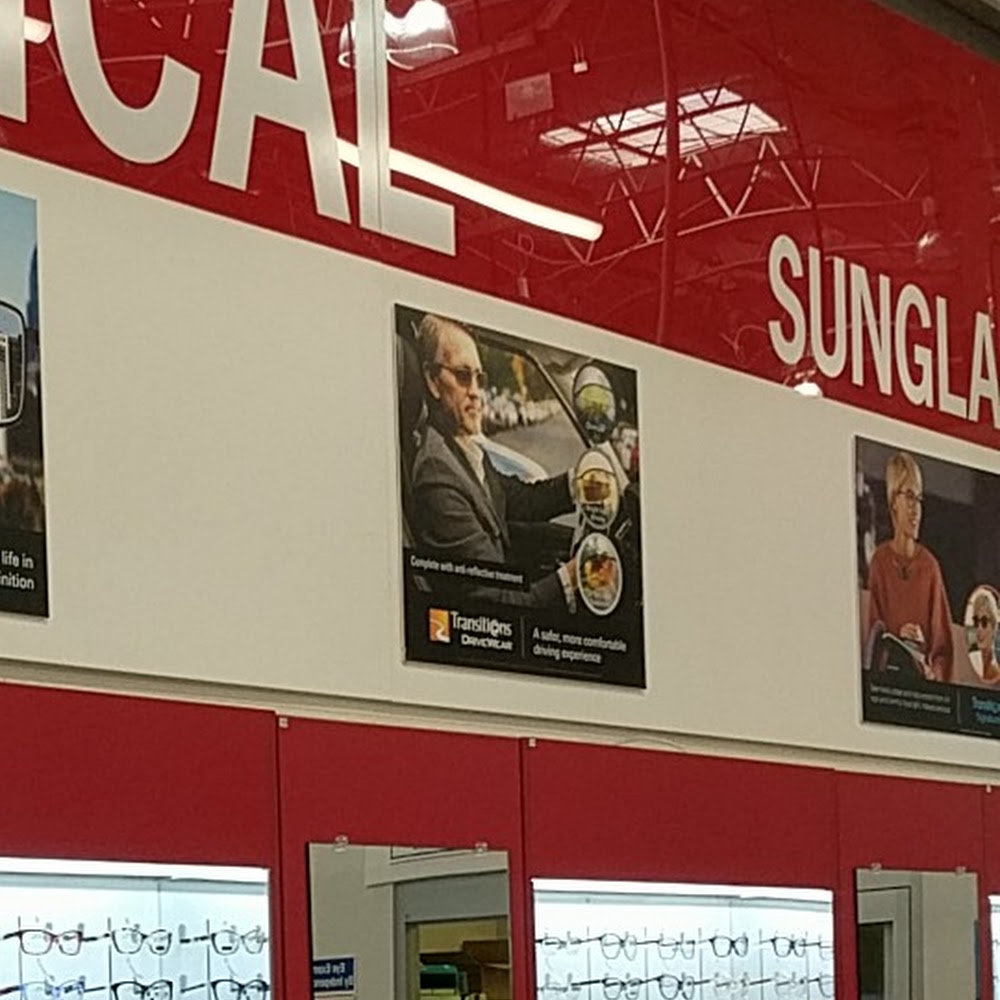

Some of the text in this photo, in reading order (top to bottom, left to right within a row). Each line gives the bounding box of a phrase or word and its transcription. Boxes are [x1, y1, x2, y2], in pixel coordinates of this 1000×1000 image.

[768, 234, 1000, 430] SUNGLA
[1, 550, 20, 567] life
[21, 553, 34, 569] in
[410, 555, 440, 572] Complete
[440, 561, 454, 574] with
[451, 611, 513, 637] Transitions
[533, 627, 541, 639] A
[562, 635, 582, 645] more
[583, 634, 627, 652] comfortable
[533, 644, 602, 665] driving experience
